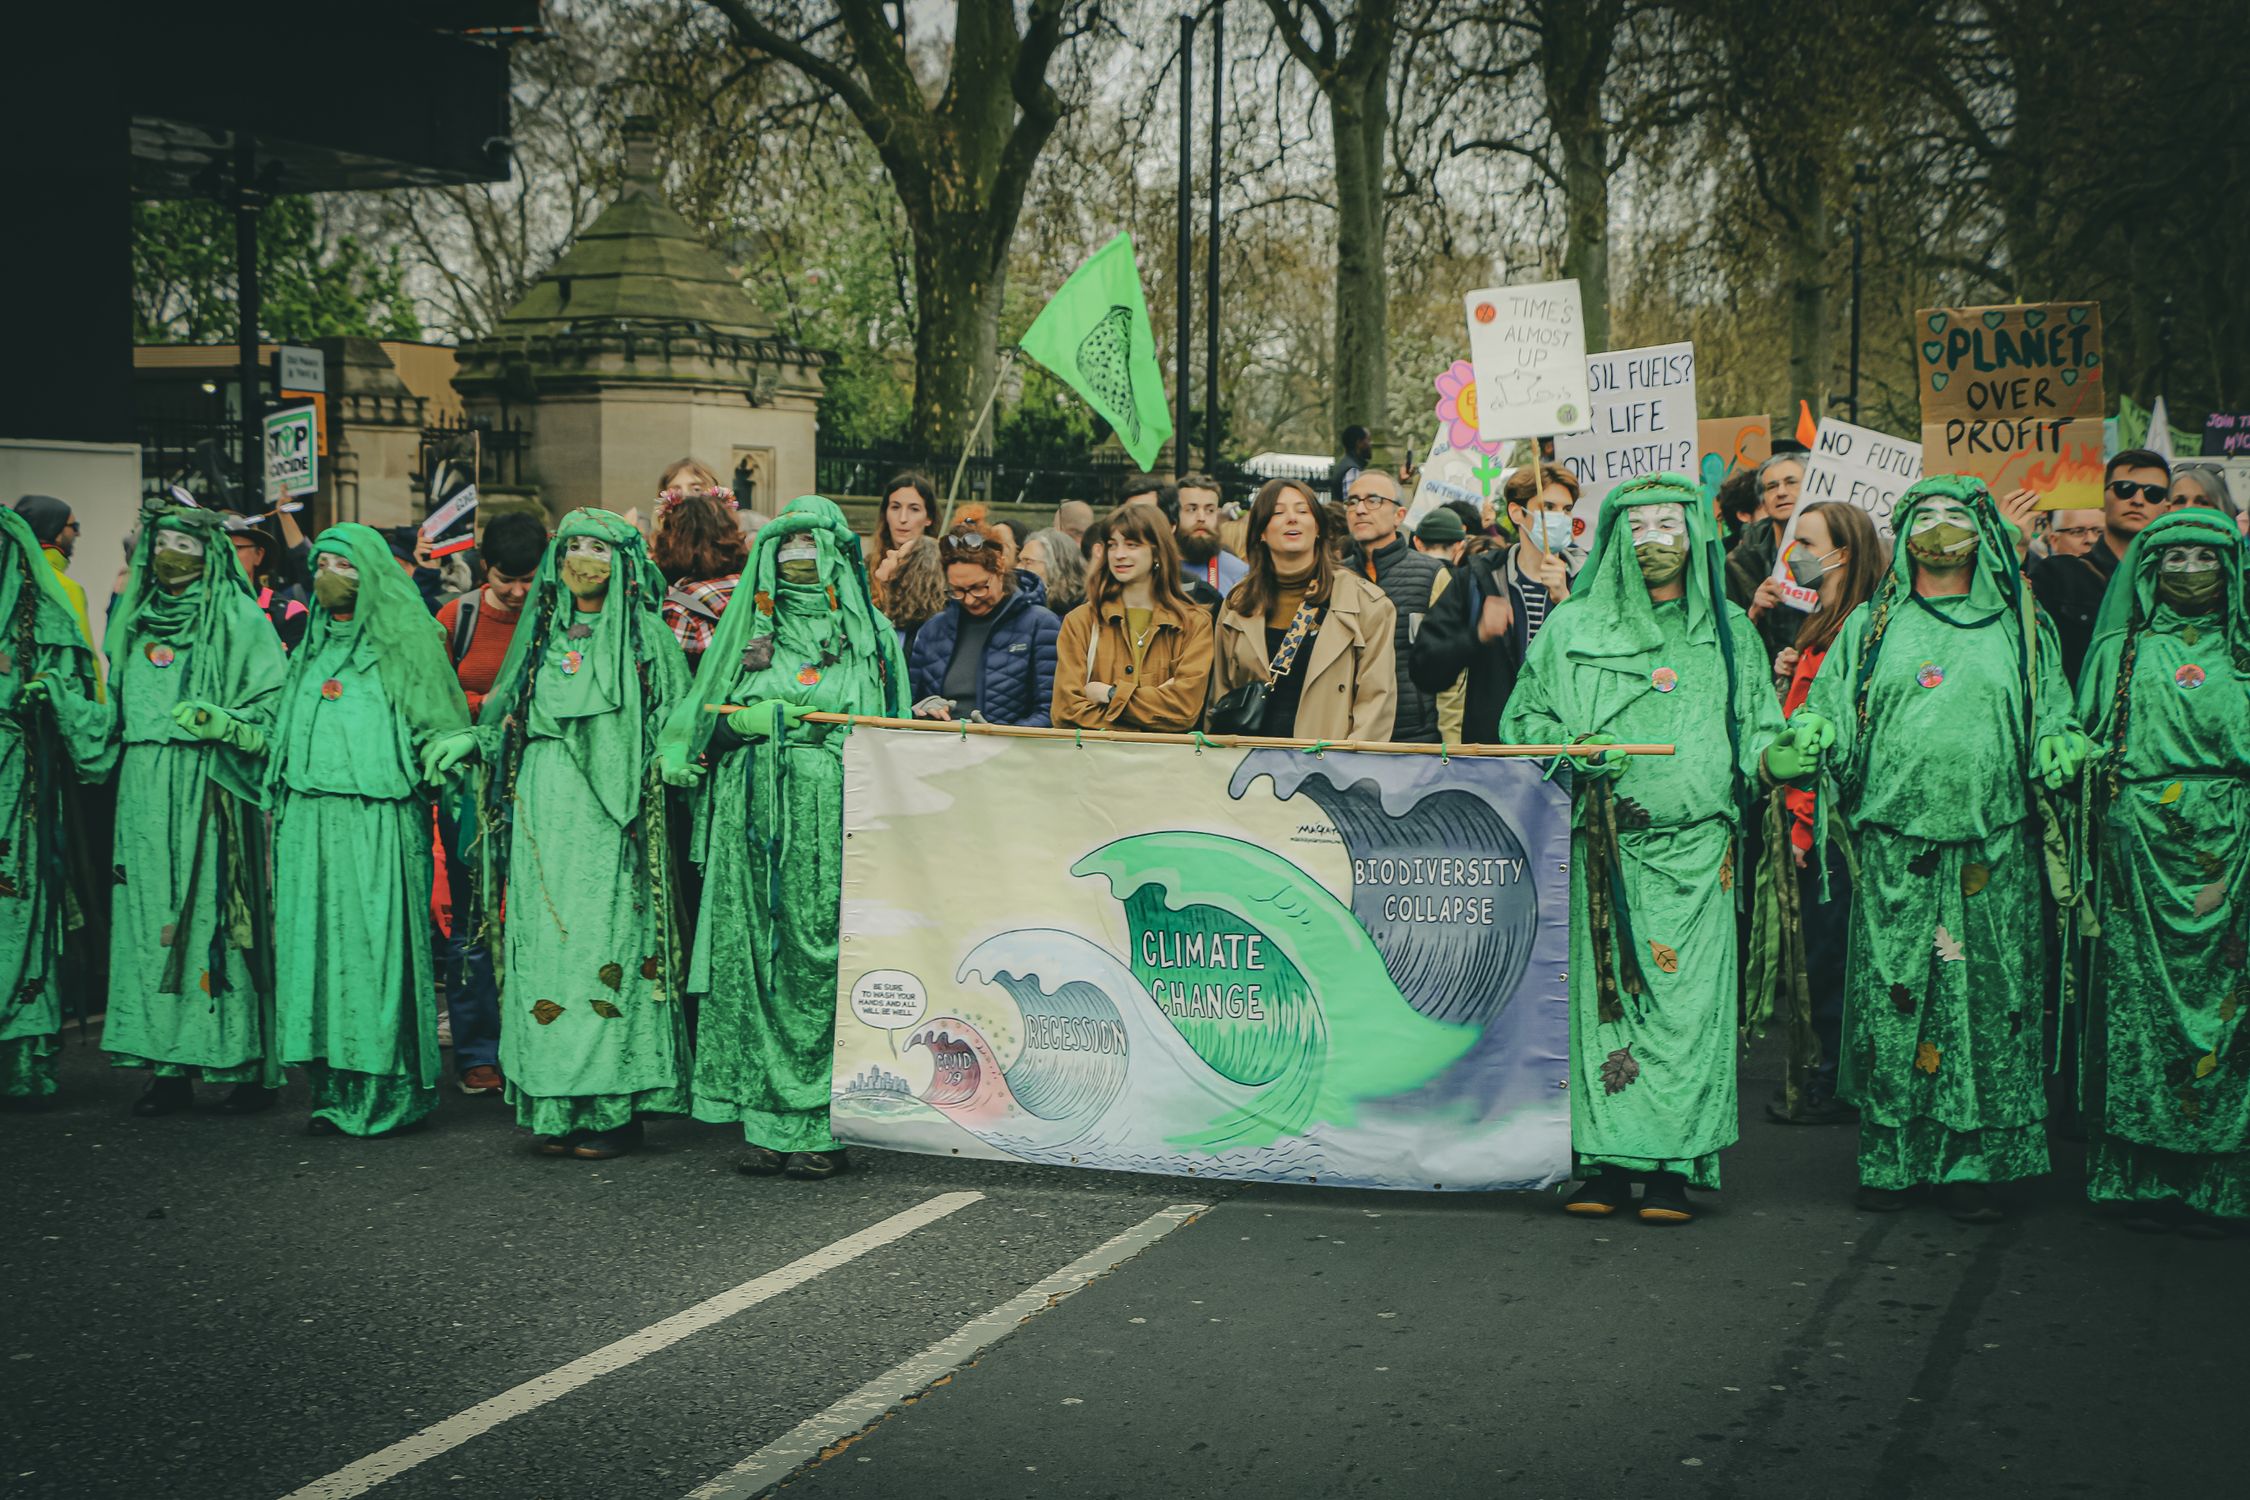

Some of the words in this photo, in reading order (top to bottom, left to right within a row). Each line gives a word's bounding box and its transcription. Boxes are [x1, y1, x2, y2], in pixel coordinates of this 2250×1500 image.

[1509, 296, 1574, 325] TIME'S
[1504, 325, 1572, 348] ALMOST
[1947, 324, 2091, 372] PLANET
[1517, 348, 1548, 368] UP
[1628, 354, 1693, 390] FUELS?
[1967, 377, 2056, 411] OVER
[1609, 400, 1665, 434] LIFE
[1820, 431, 1852, 456] NO
[1946, 416, 2076, 456] PROFIT
[1563, 455, 1596, 484] ON
[1806, 468, 1837, 497] IN
[1779, 581, 1819, 604] hell
[1354, 857, 1524, 887] BIODIVERSITY
[1384, 895, 1495, 925] COLLAPSE
[1142, 930, 1265, 970] CLIMATE
[873, 983, 882, 991] BE
[883, 984, 903, 992] SURE
[873, 991, 895, 999] WASH
[897, 992, 916, 1000] YOUR
[1151, 978, 1264, 1020] CHANGE
[862, 1007, 880, 1015] WILL
[885, 1000, 901, 1008] AND
[1026, 1014, 1128, 1057] RECESSION
[936, 1051, 972, 1072] COVID
[944, 1071, 963, 1087] 19
